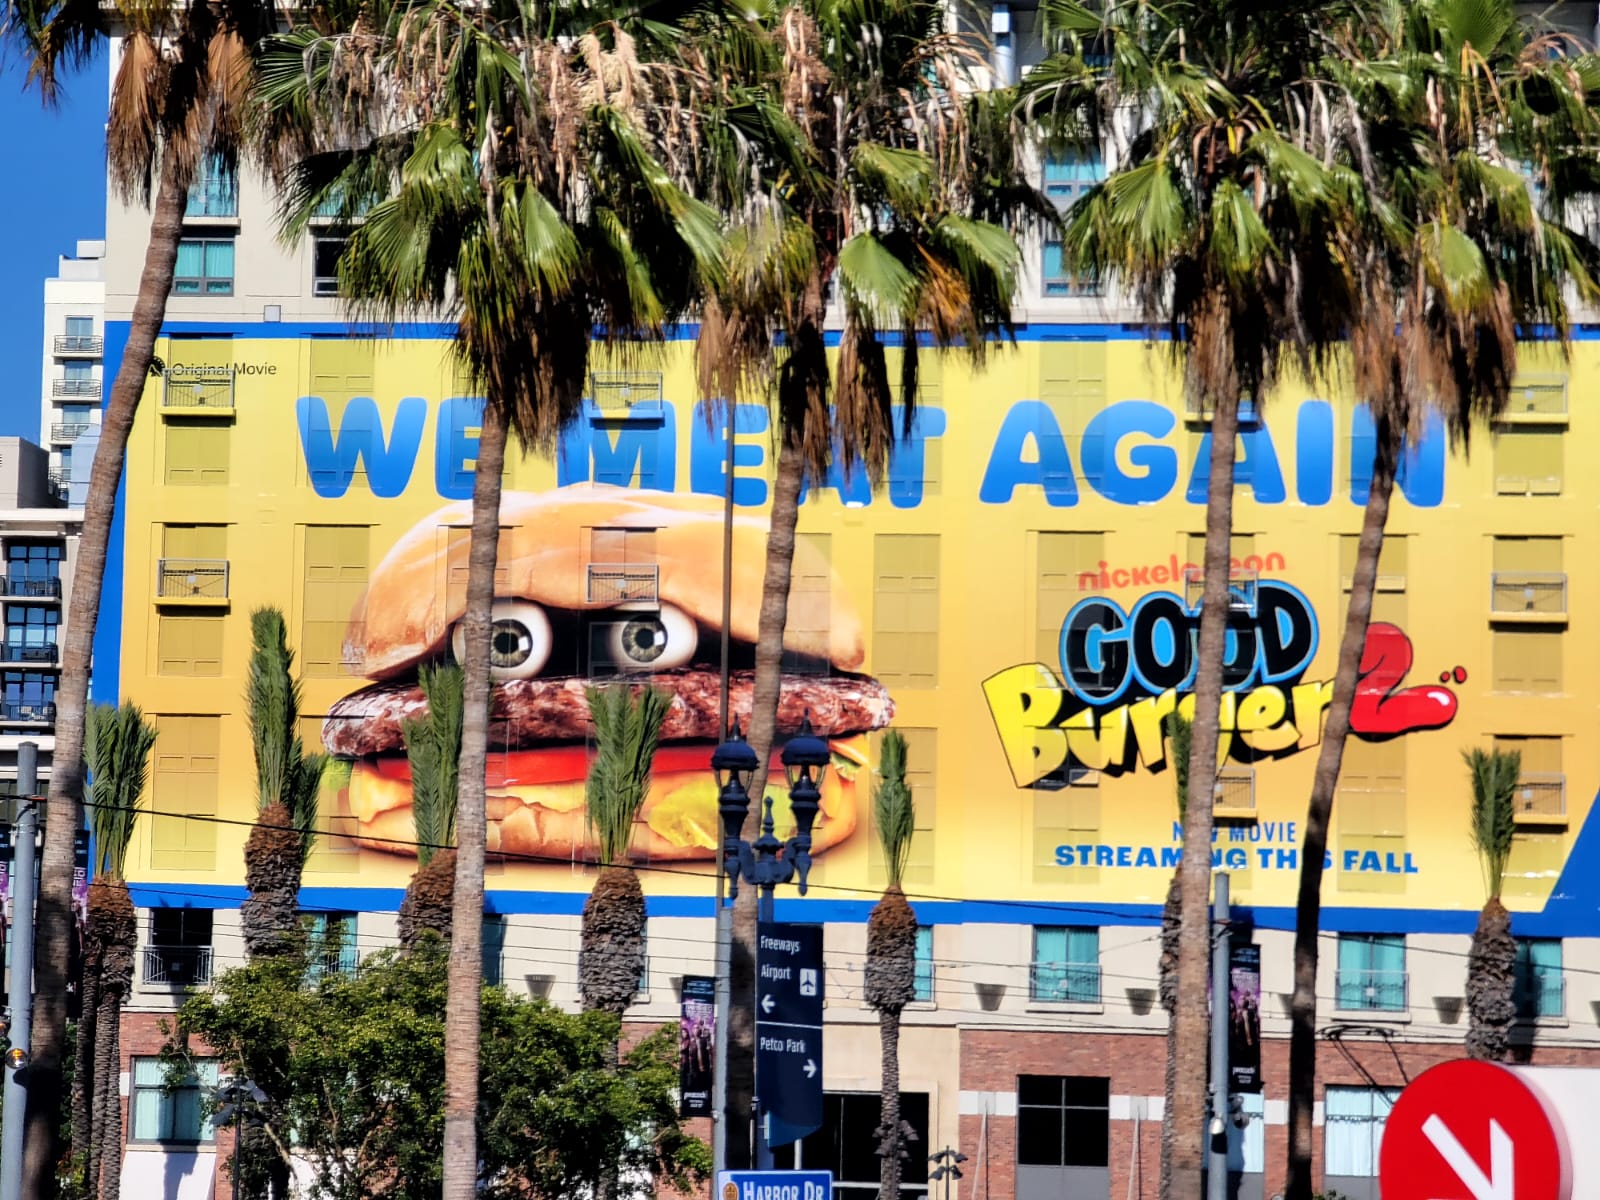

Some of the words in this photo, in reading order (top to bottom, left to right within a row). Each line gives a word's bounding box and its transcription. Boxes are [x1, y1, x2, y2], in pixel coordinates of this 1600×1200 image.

[172, 362, 230, 379] Original
[233, 362, 277, 375] Movie
[296, 396, 490, 500] WE
[979, 399, 1445, 508] AGAIN
[1078, 552, 1286, 591] nickeloeon
[1349, 622, 1459, 736] 2
[1229, 822, 1296, 842] MOVIE
[1055, 845, 1247, 869] STREAMNG
[1257, 848, 1332, 870] TH
[1343, 850, 1418, 873] FALL
[760, 935, 800, 955] Freeways
[761, 963, 791, 981] Airport
[760, 1037, 783, 1052] Petco
[786, 1038, 806, 1053] Park
[743, 1181, 799, 1200] HARBOR
